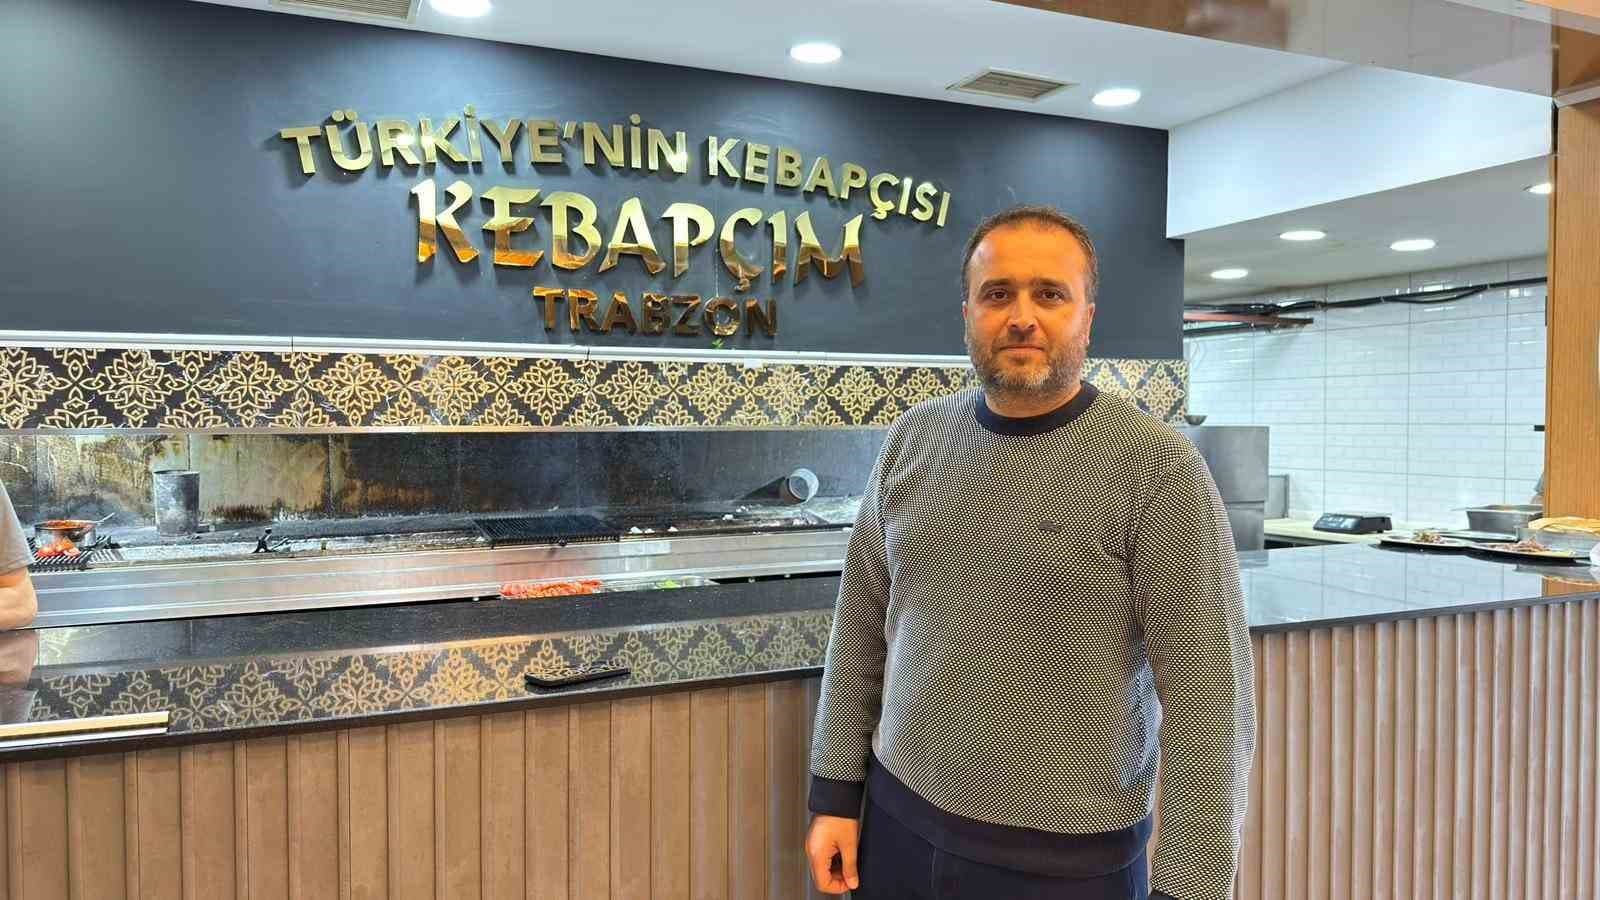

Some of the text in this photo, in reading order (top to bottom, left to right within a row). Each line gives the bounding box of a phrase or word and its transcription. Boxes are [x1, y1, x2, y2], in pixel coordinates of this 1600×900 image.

[280, 103, 951, 228] TÜRKİYE'NİN KEBAPÇISI
[409, 178, 865, 292] KEBAPÇIM
[532, 285, 778, 337] TRABZON
